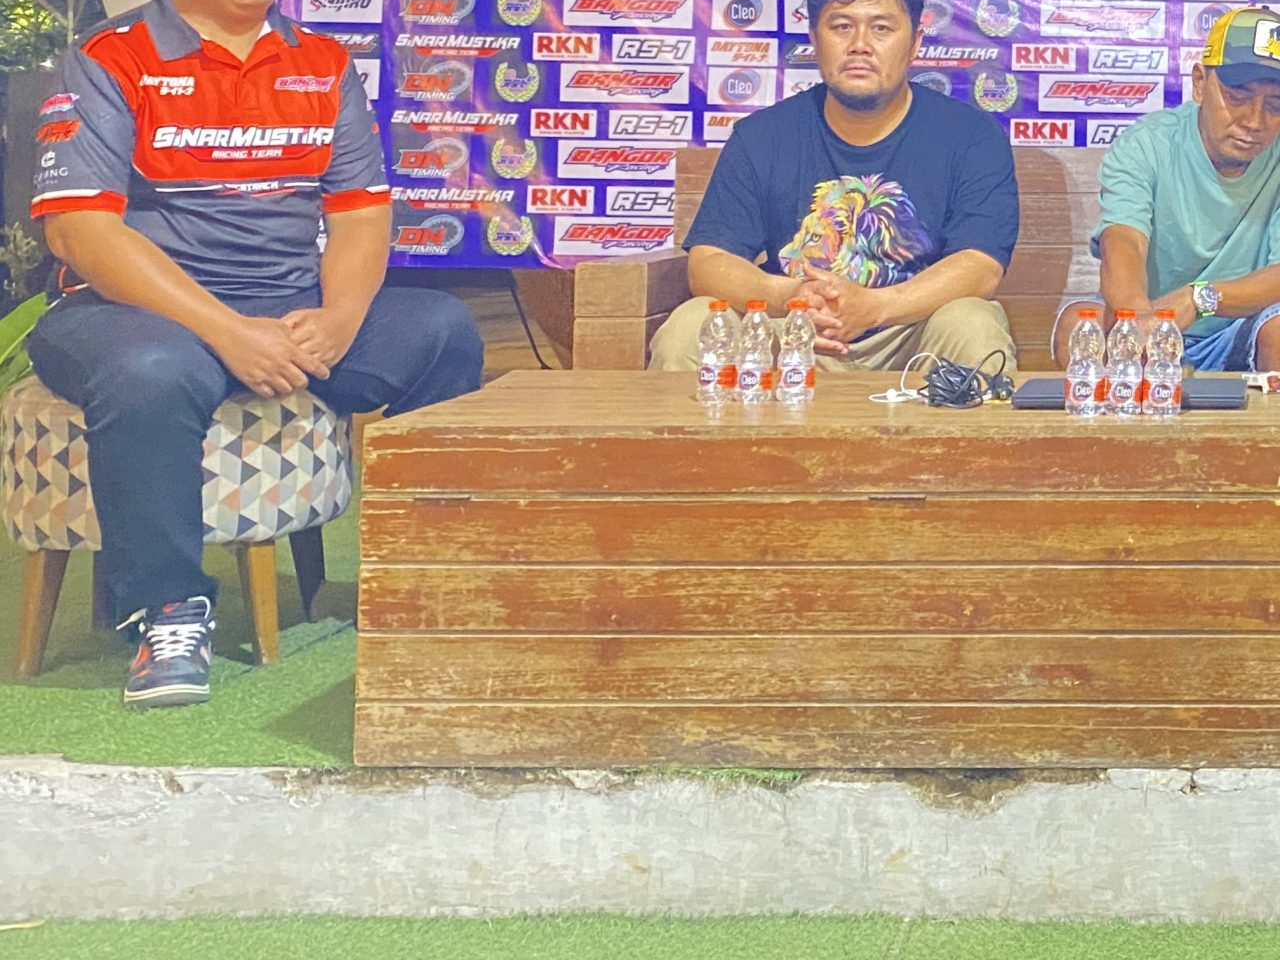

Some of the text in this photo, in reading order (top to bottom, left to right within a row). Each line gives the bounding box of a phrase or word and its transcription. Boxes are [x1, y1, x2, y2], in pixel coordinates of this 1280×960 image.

[419, 15, 460, 25] TIMING
[730, 5, 756, 20] Cleo
[536, 35, 594, 54] RKN
[616, 38, 690, 60] RS-1
[710, 41, 770, 53] DAYTONA
[1015, 46, 1071, 65] RKN
[1093, 49, 1165, 70] RS-1
[140, 74, 195, 87] DAYTONA
[566, 70, 684, 89] BANGOR
[726, 78, 753, 96] Cleo
[415, 91, 456, 101] TIMING
[1044, 80, 1160, 99] BANGOR
[534, 112, 591, 131] RKN
[613, 115, 688, 136] RS-1
[1014, 121, 1068, 139] RKN
[212, 148, 283, 159] RACING TEAM
[563, 146, 677, 165] BANGOR
[411, 167, 452, 178] TIMING
[531, 188, 588, 207] RKN
[560, 222, 674, 242] BANGOR
[410, 244, 449, 255] TIMING
[1075, 385, 1091, 396] Cleo
[1116, 386, 1132, 397] Cleo
[1155, 387, 1171, 398] Cleo
